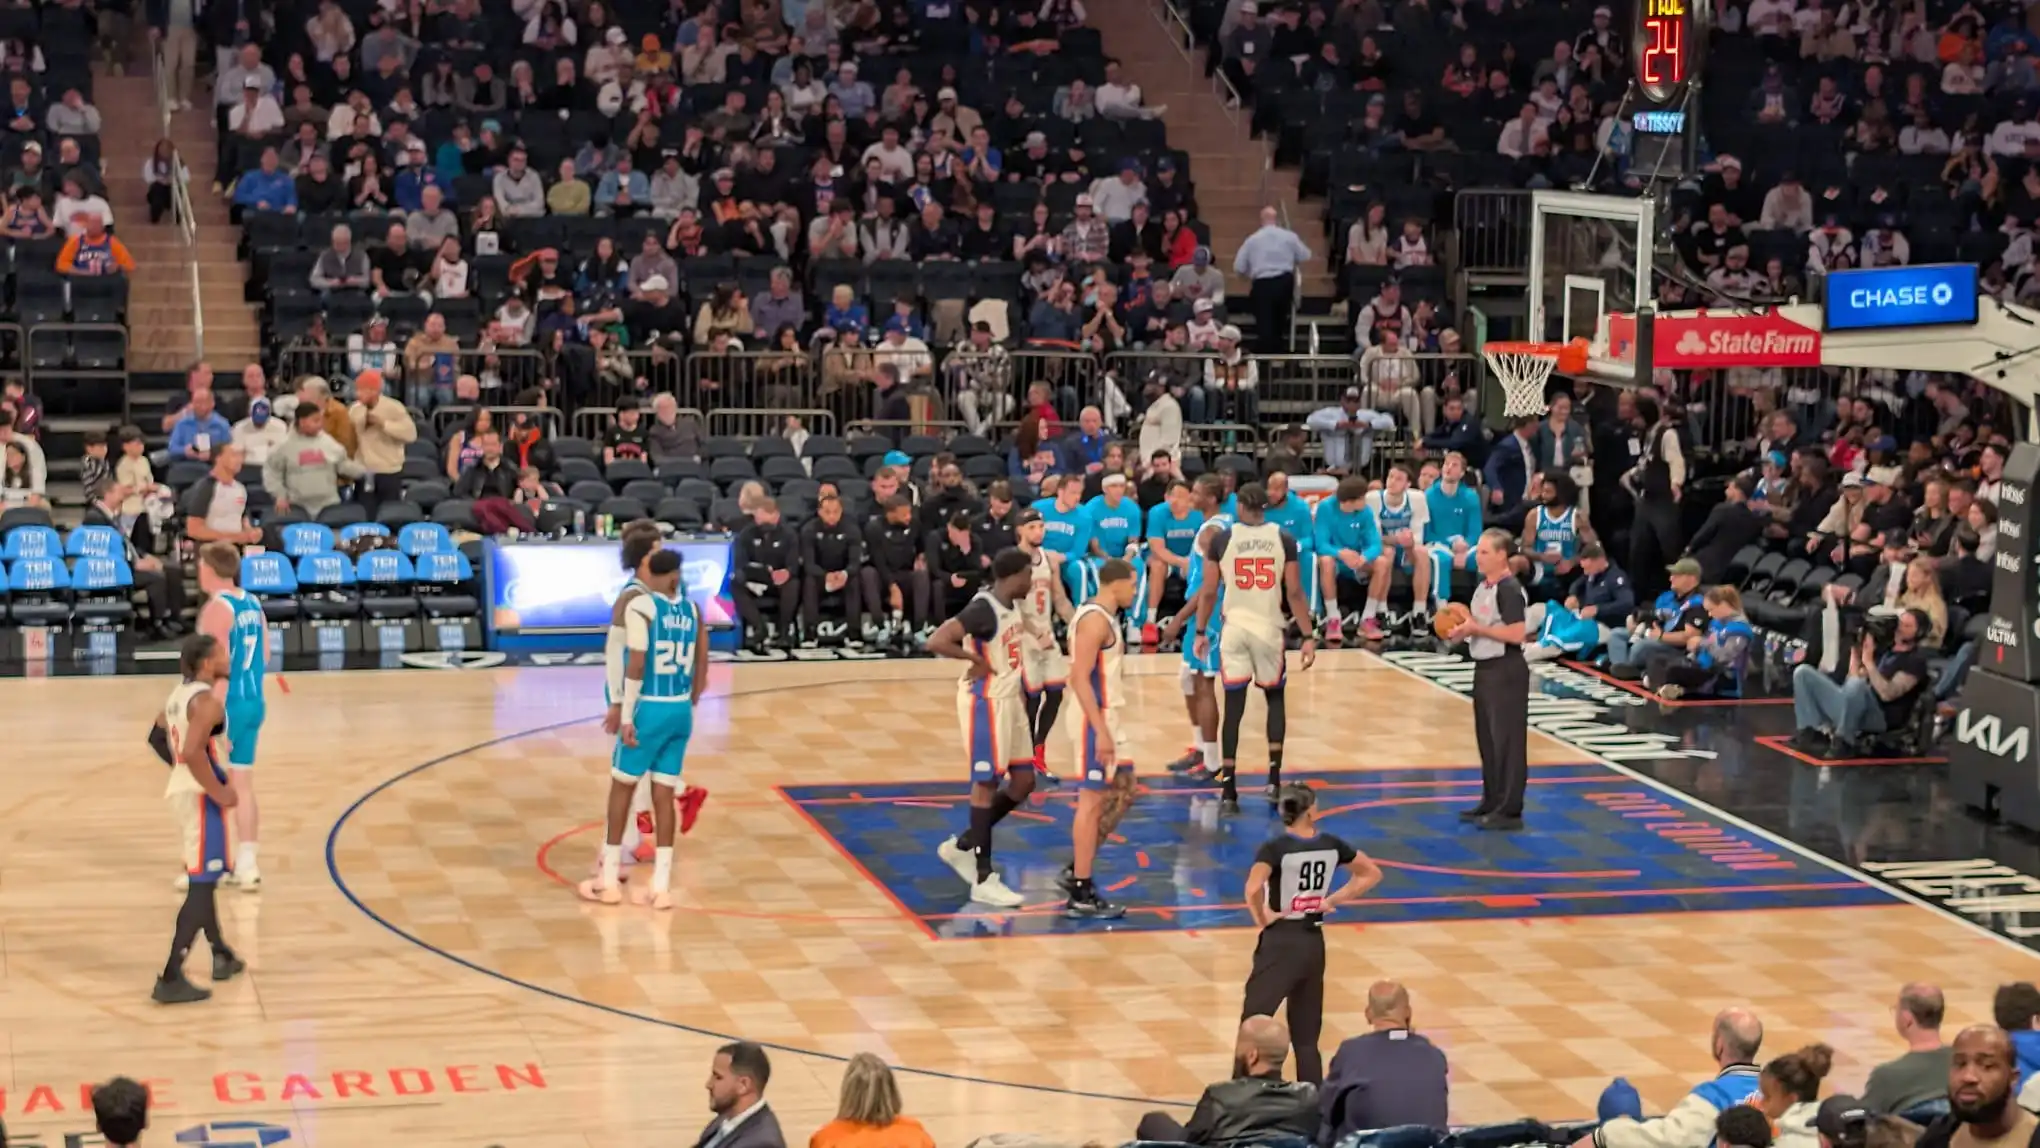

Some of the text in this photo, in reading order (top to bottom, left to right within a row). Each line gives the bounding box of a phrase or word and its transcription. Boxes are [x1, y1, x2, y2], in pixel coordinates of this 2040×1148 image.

[1645, 20, 1680, 82] 24
[1647, 112, 1685, 133] TISSOT
[1851, 285, 1928, 308] CHASE
[253, 559, 279, 570] TEN
[314, 557, 341, 568] TEN
[1235, 557, 1276, 600] 55
[242, 634, 258, 670] 7
[1987, 626, 2018, 647] ULTRA
[529, 646, 886, 664] FAUEL
[655, 640, 697, 677] 24
[1957, 708, 2029, 762] KIA
[1298, 860, 1326, 891] 98
[212, 1063, 548, 1104] GARDEN
